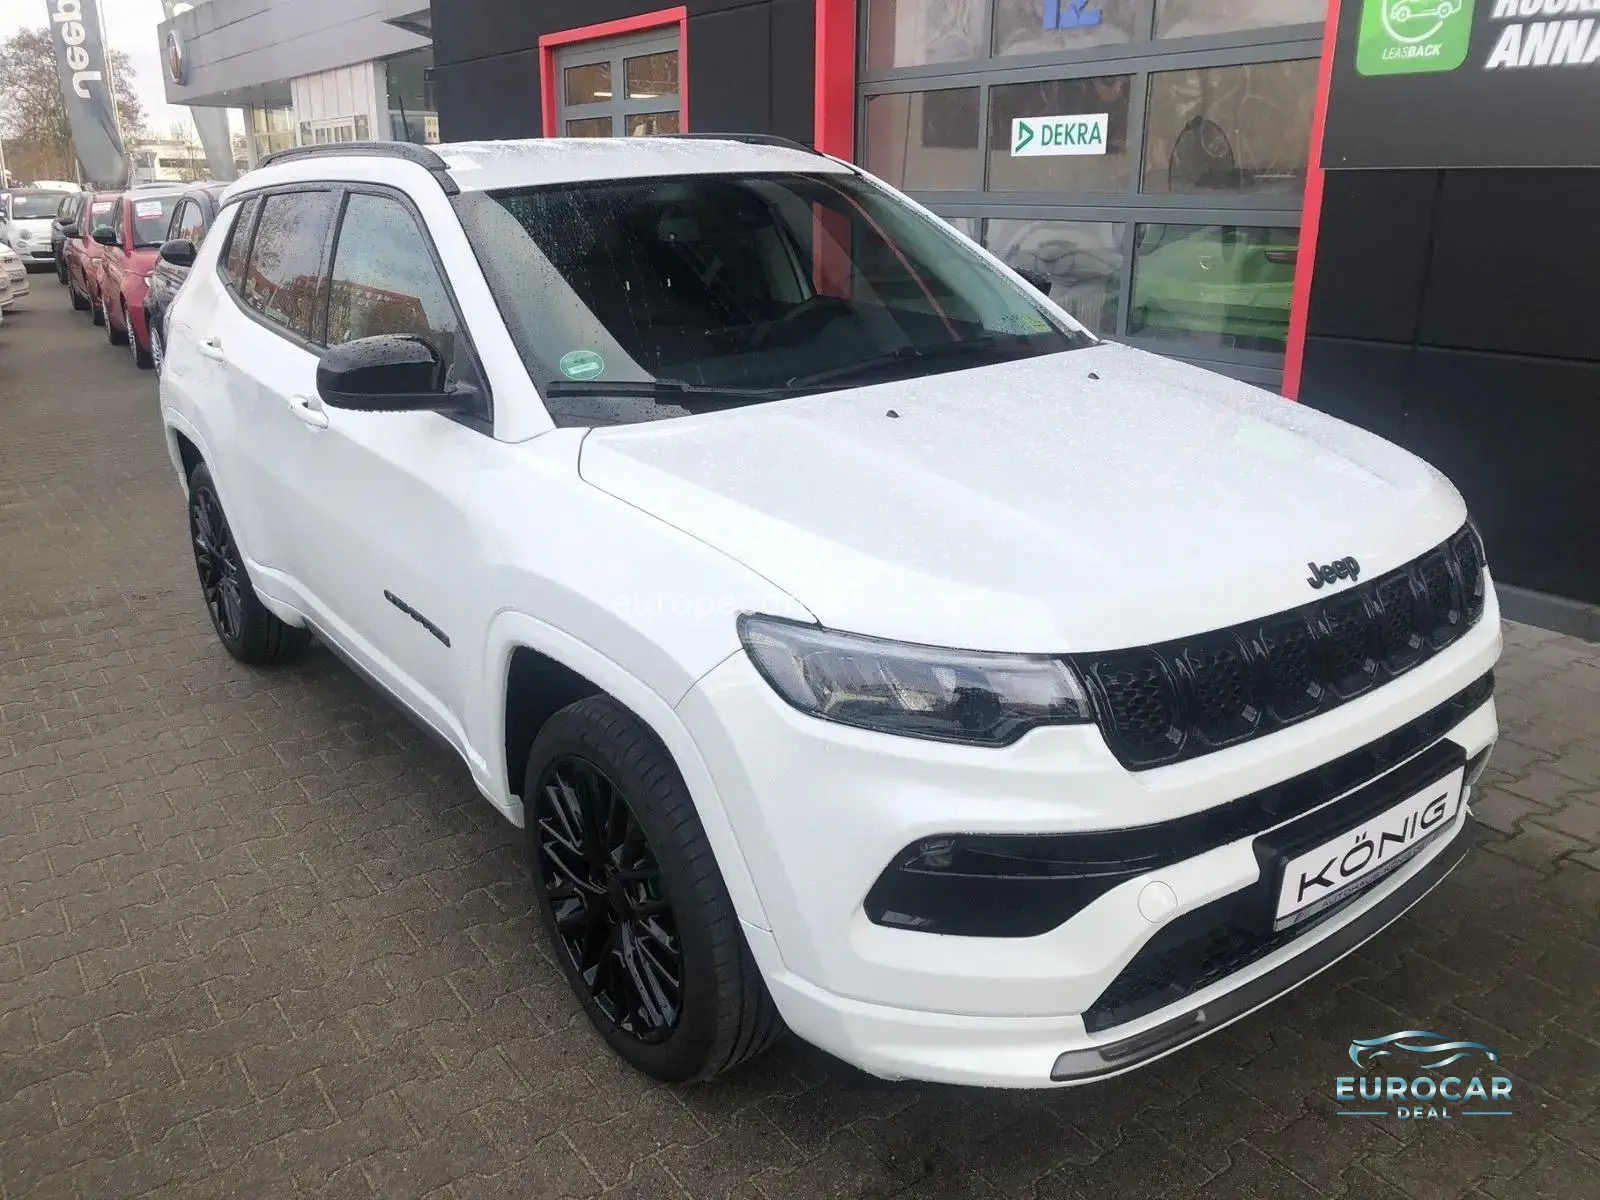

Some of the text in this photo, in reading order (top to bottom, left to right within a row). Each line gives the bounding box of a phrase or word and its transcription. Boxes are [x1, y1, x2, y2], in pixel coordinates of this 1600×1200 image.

[52, 0, 102, 98] Jeep
[1382, 43, 1442, 60] LEASBACK
[1041, 121, 1103, 147] DEKRA
[1306, 556, 1361, 590] Jeep
[1297, 791, 1449, 903] KÖNIG
